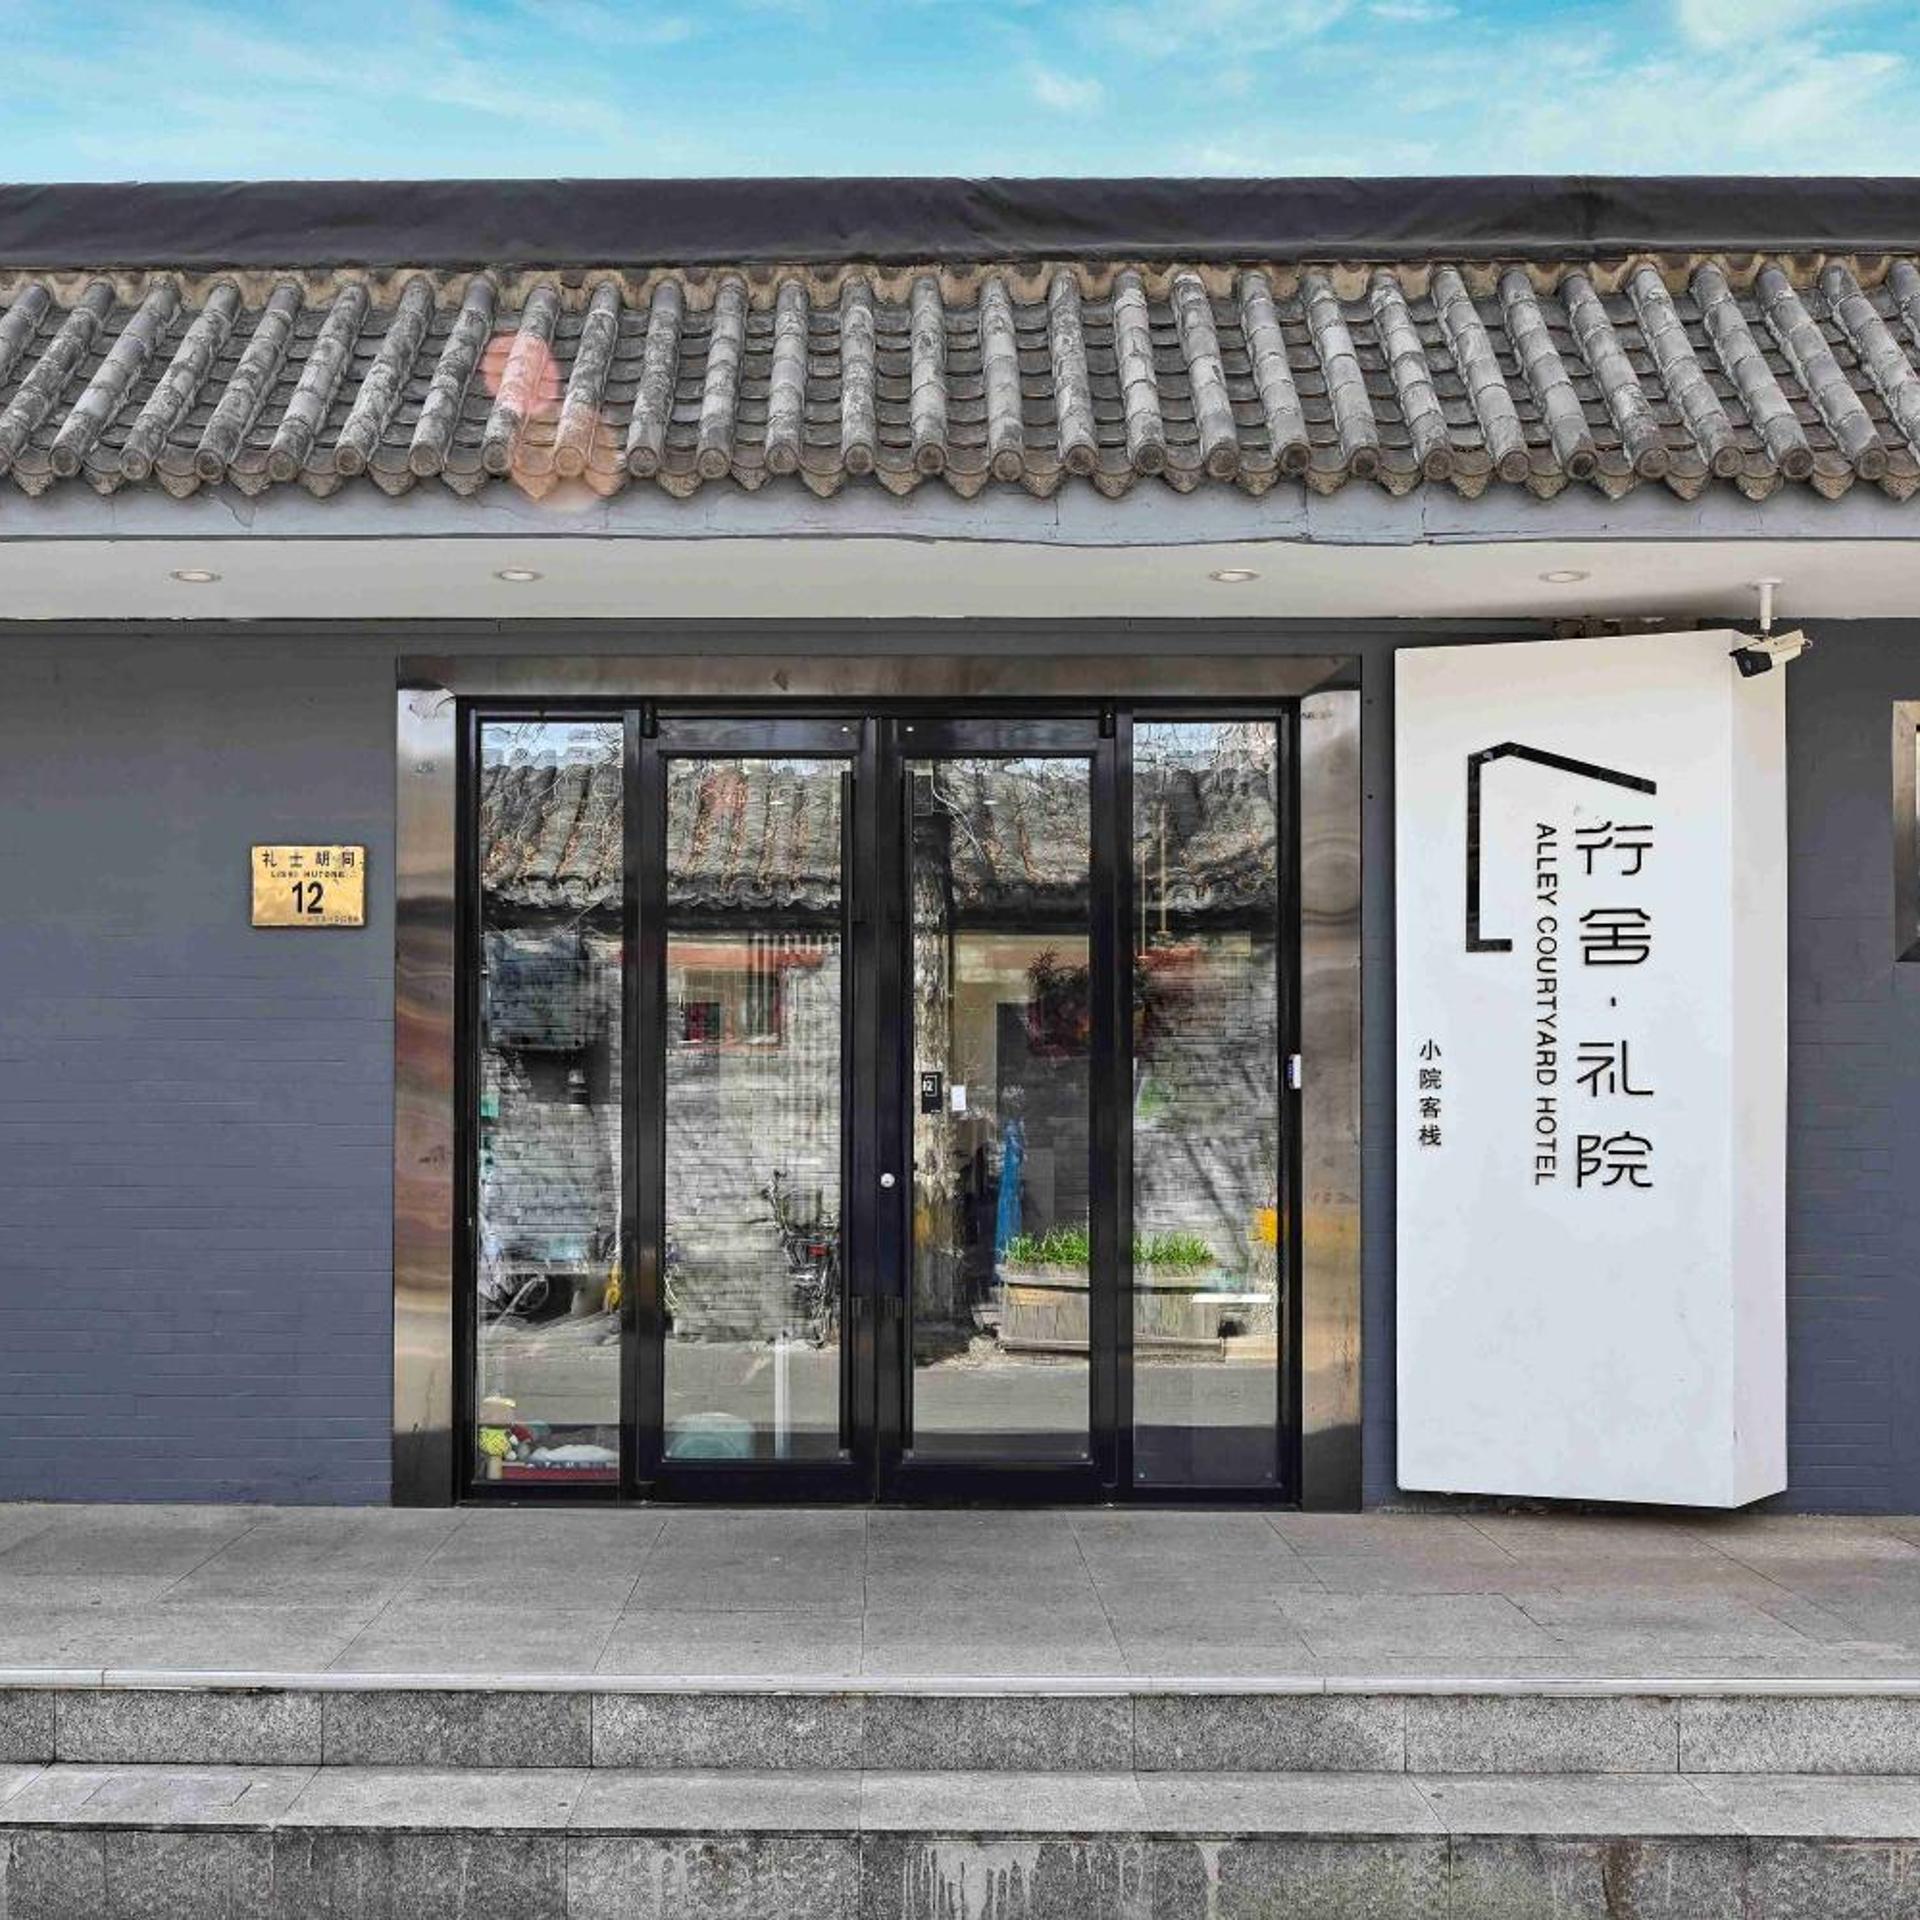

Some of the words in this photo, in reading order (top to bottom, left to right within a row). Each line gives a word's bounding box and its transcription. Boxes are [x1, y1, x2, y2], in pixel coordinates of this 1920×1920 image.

[292, 881, 324, 914] 12
[1535, 823, 1558, 906] ALLEY
[1535, 917, 1558, 1086] COURTYARD
[1419, 1039, 1442, 1148] 小院客栈
[1535, 1098, 1557, 1186] HOTEL
